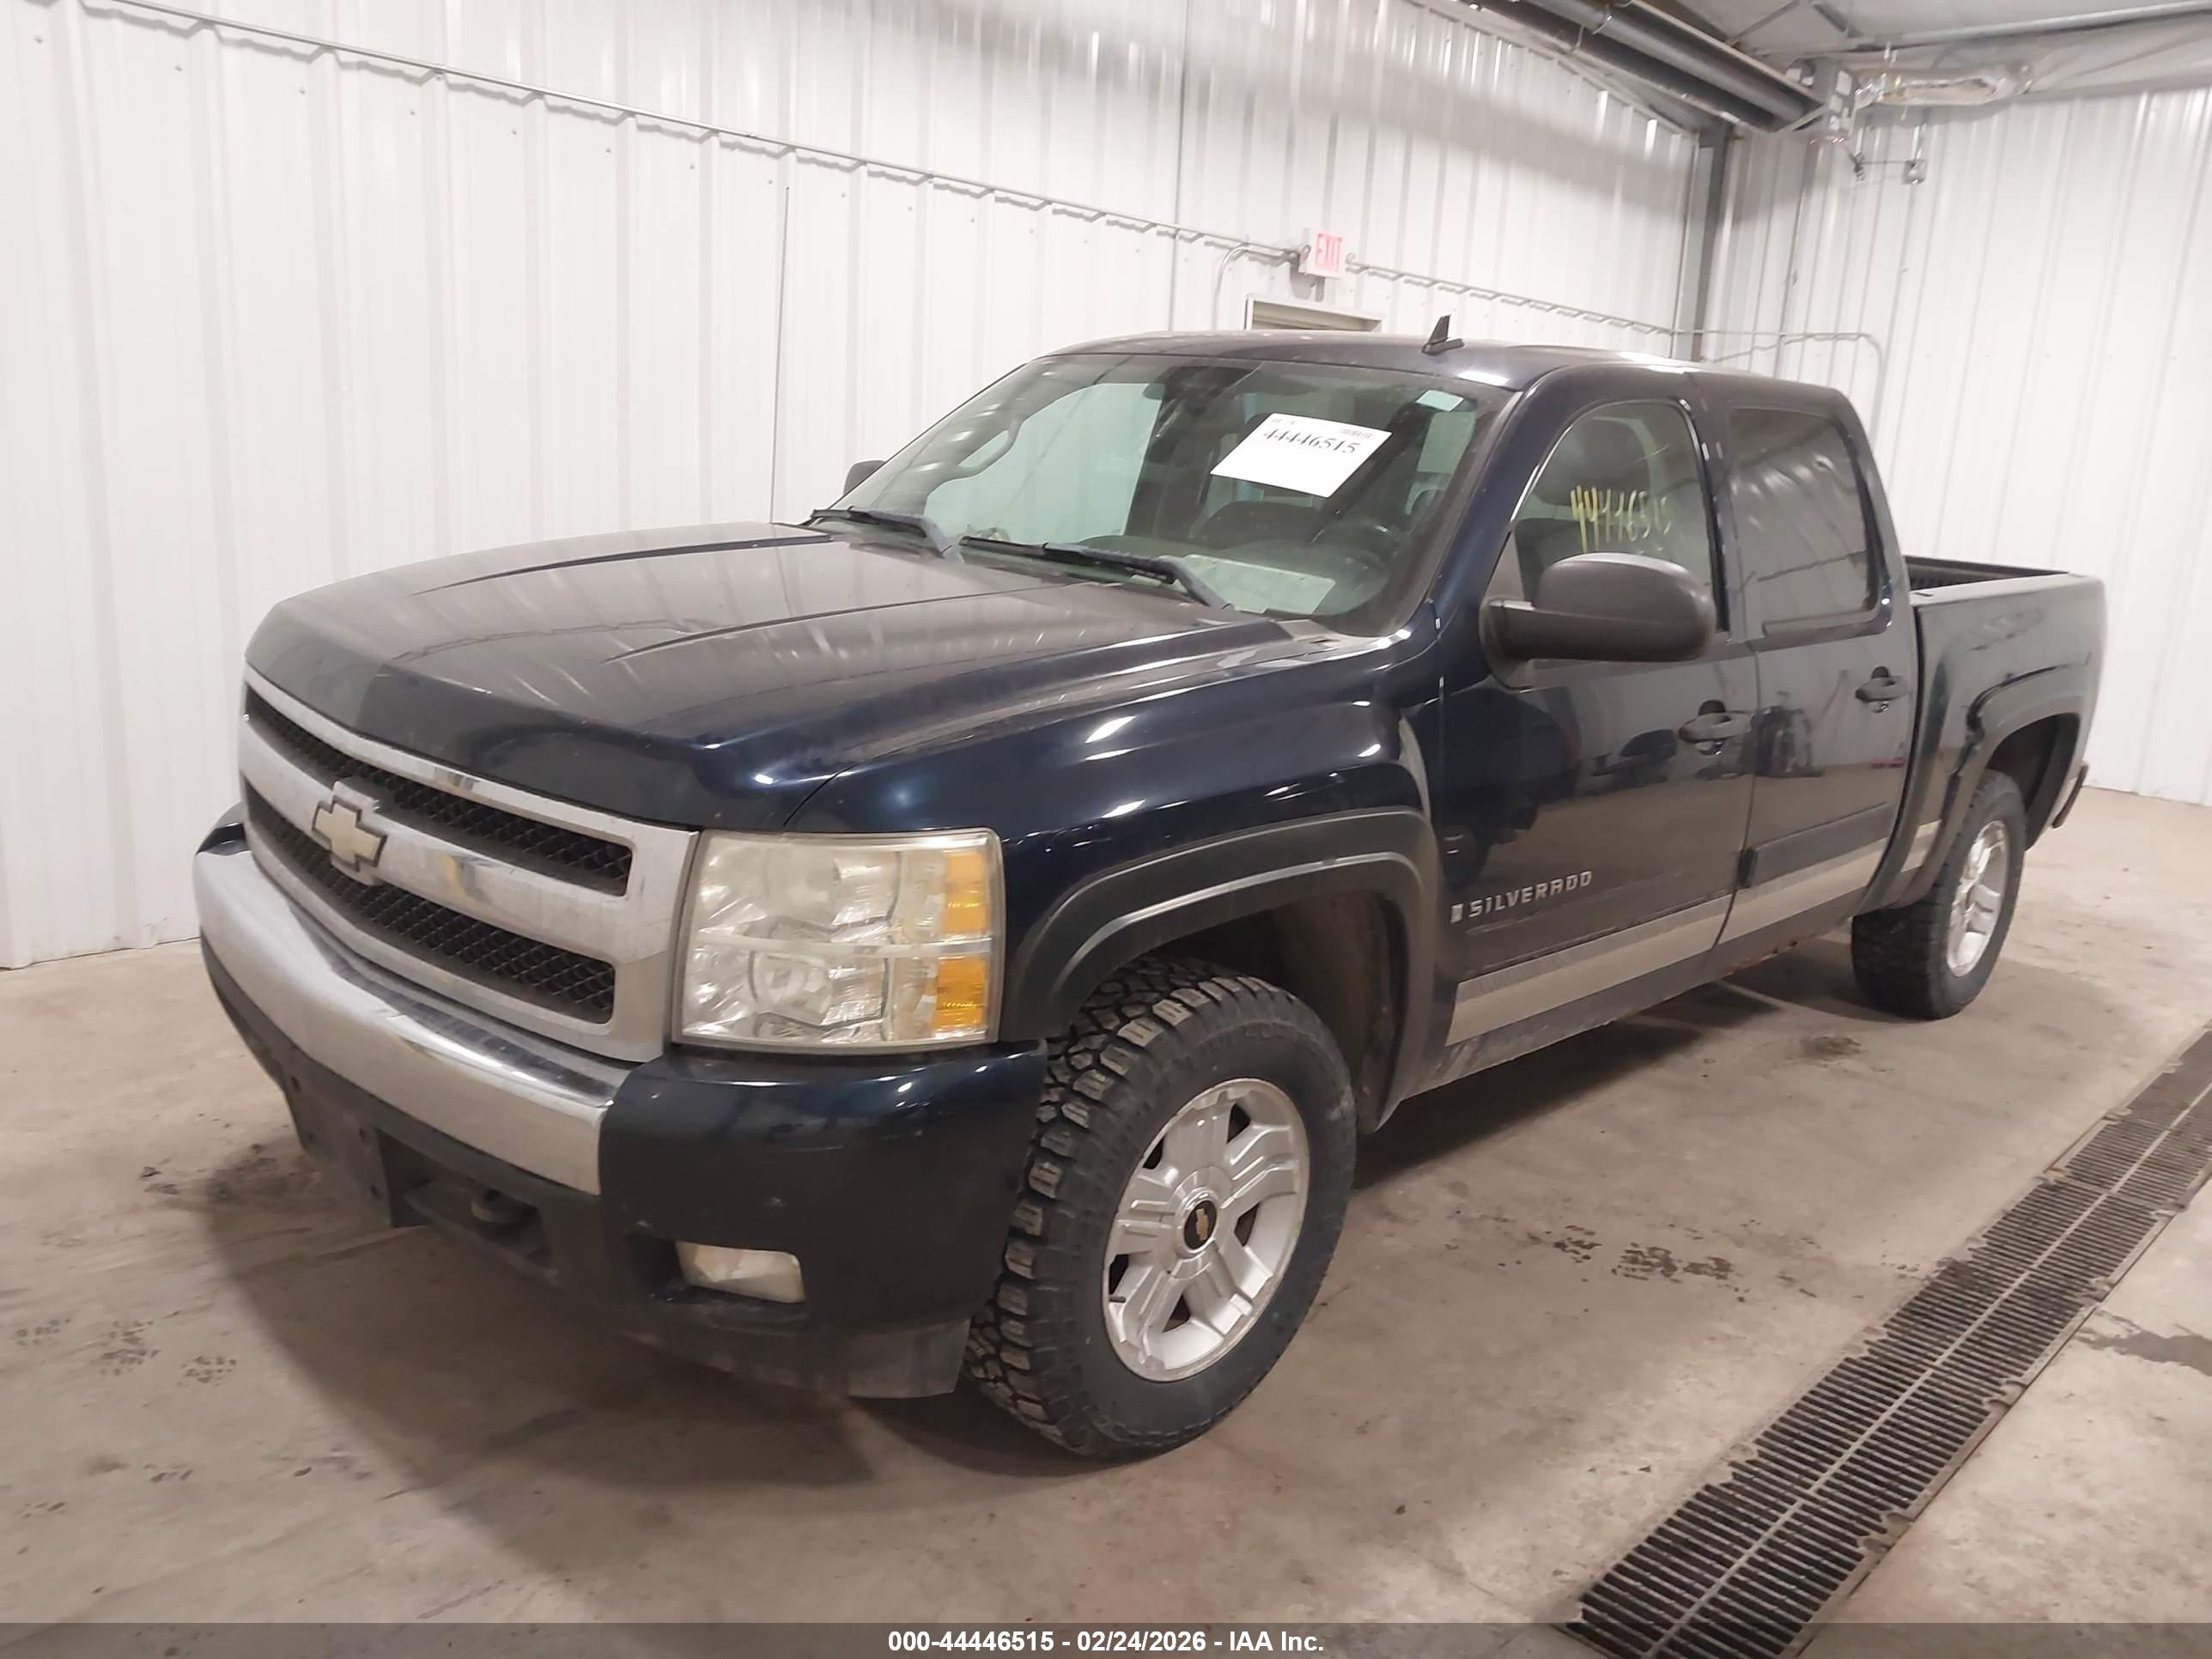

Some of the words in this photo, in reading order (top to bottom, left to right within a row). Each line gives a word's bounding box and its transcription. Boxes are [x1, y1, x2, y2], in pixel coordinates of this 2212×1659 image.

[1315, 233, 1343, 272] EXIT
[1264, 428, 1361, 454] 44446515
[1468, 870, 1593, 918] SILVERADO
